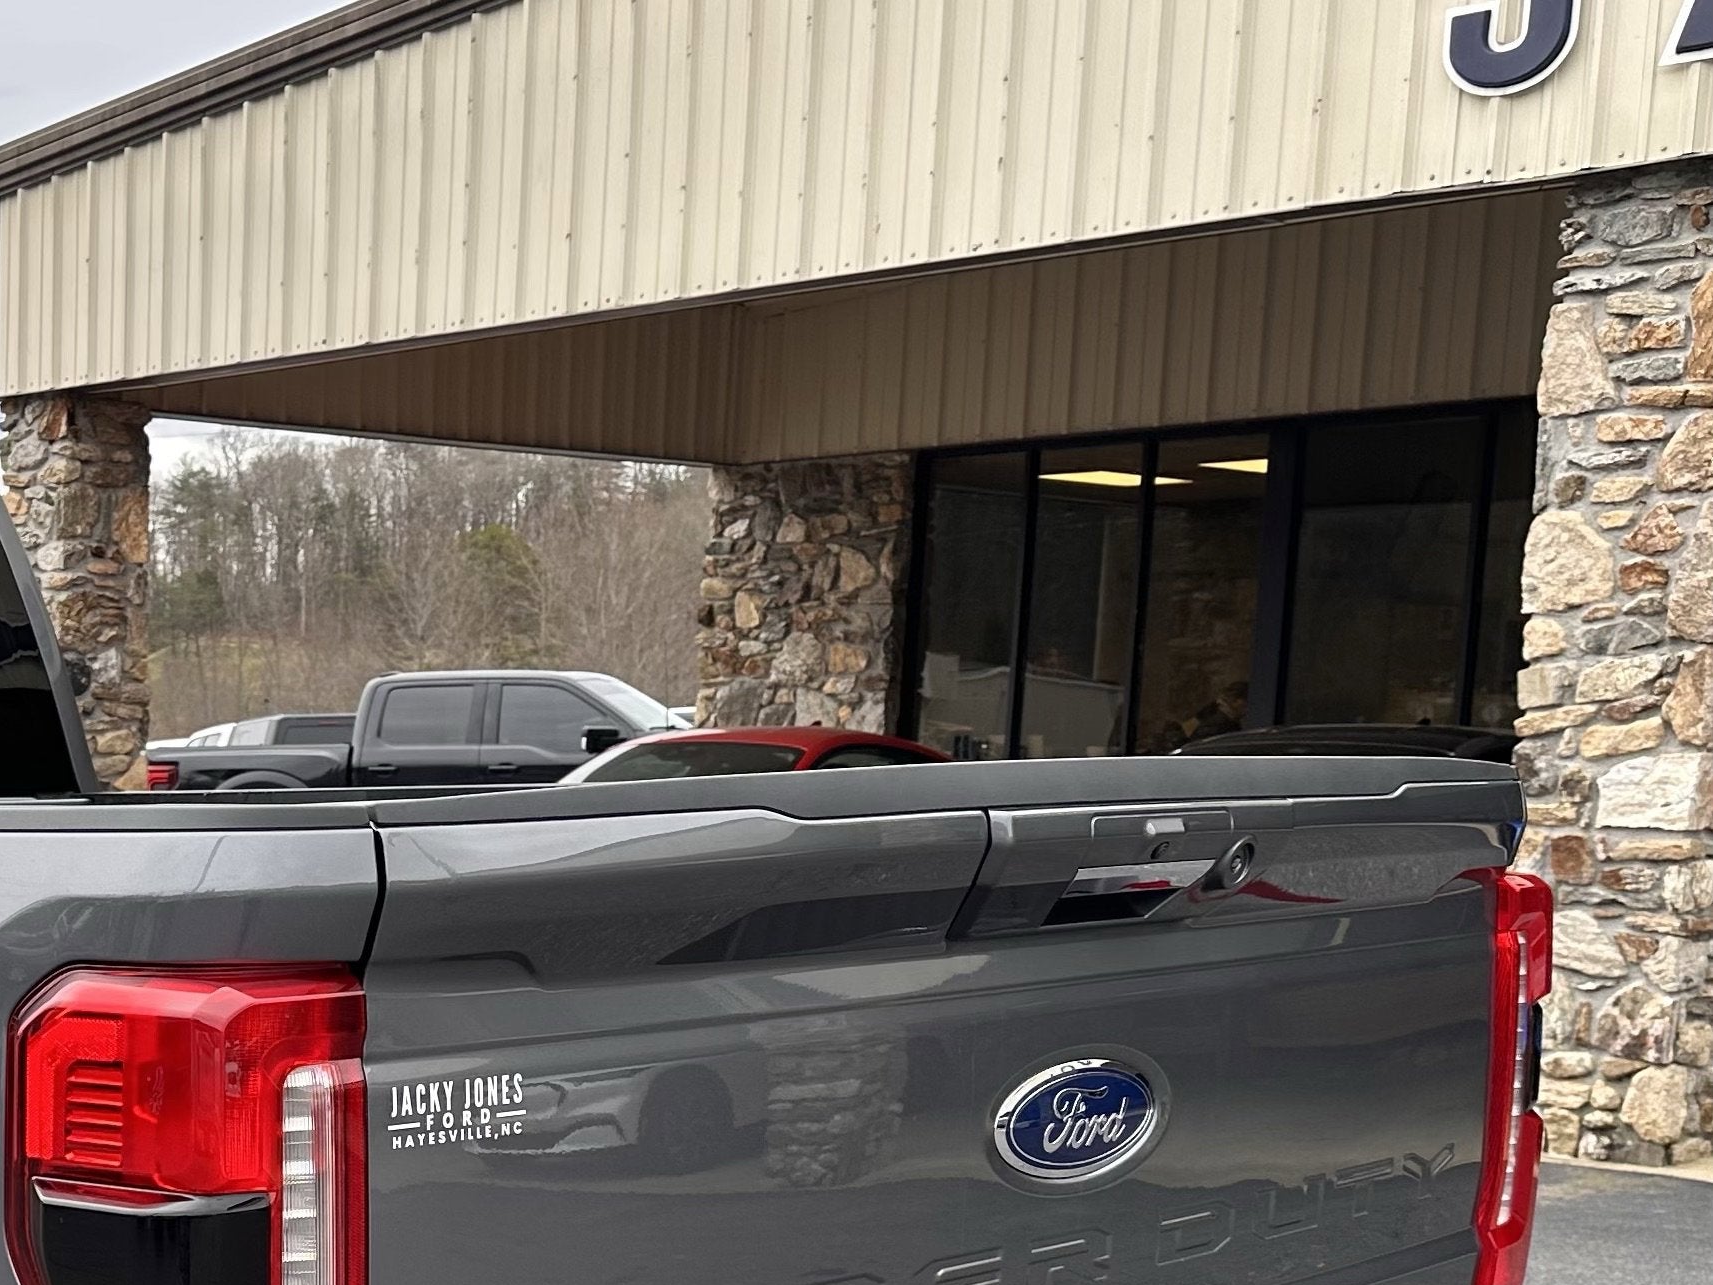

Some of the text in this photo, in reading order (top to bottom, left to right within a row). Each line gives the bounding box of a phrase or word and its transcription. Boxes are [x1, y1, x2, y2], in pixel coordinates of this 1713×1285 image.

[391, 1072, 523, 1118] JACKY JONES
[426, 1107, 491, 1131] FORD
[1043, 1085, 1129, 1153] Ford
[1155, 1142, 1455, 1267] DUTY
